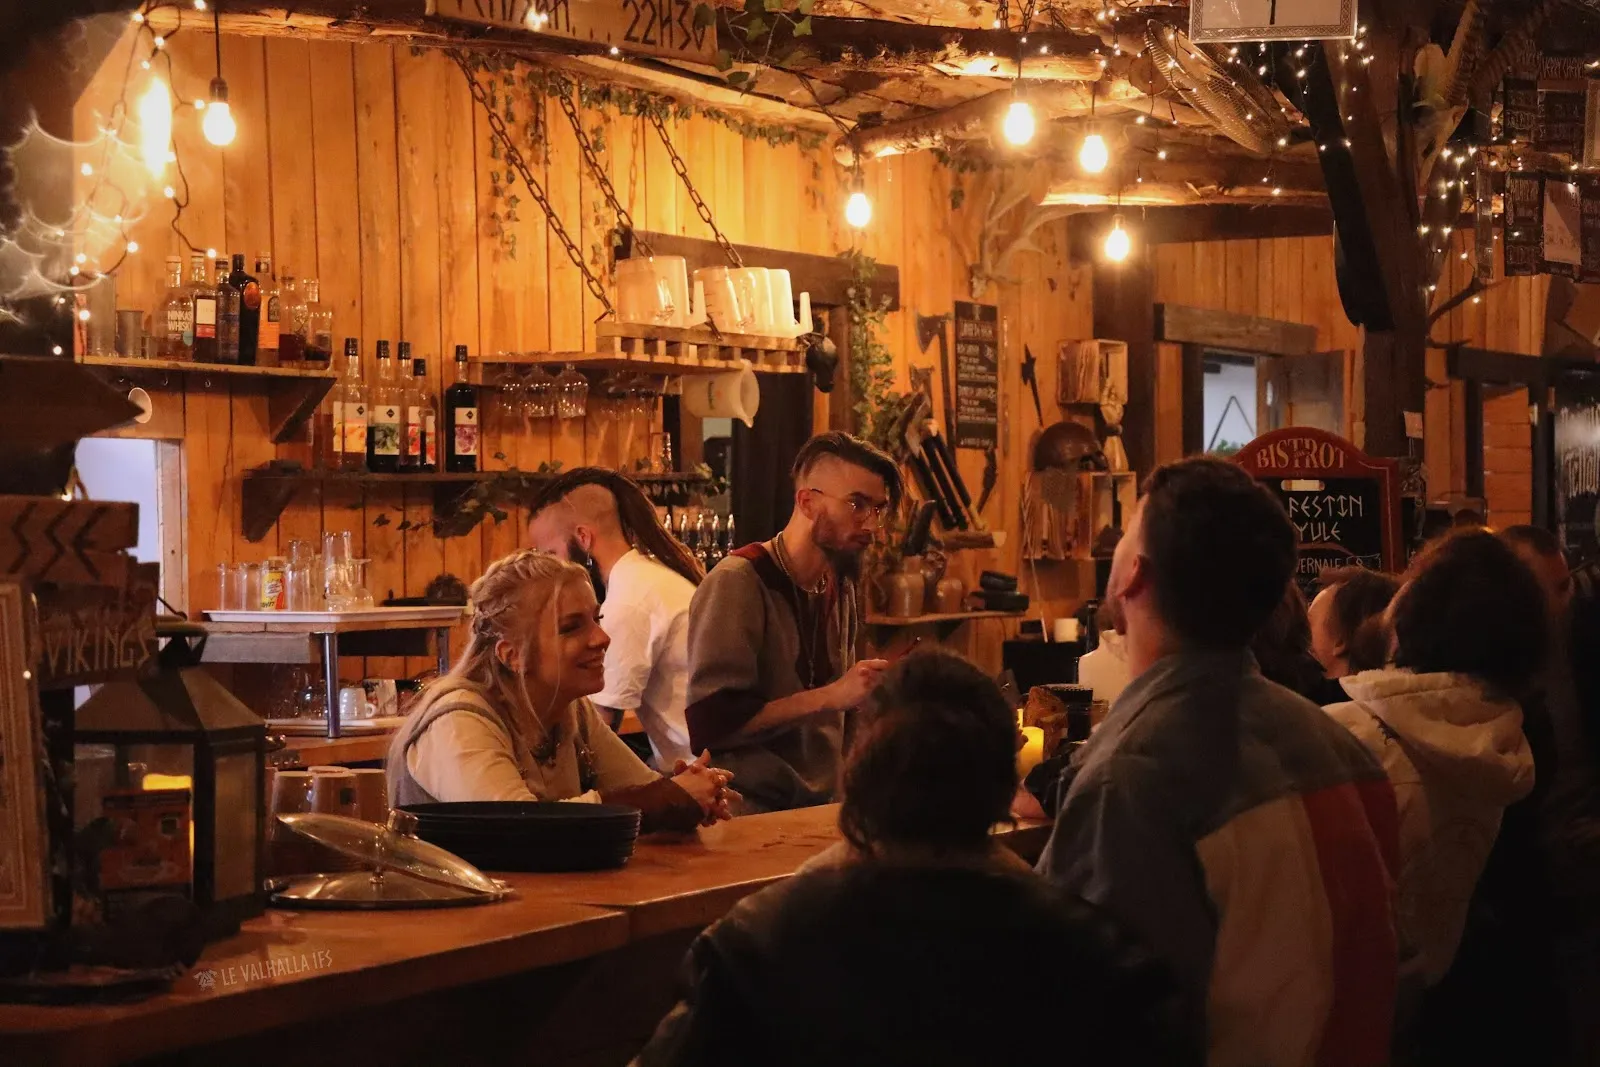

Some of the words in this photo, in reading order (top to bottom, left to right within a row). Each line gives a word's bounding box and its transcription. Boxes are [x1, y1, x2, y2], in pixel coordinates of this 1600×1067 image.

[1256, 438, 1347, 468] BISTROT
[1288, 494, 1363, 518] FESTIN
[1293, 522, 1341, 541] YULE
[44, 624, 152, 678] VIKINGS
